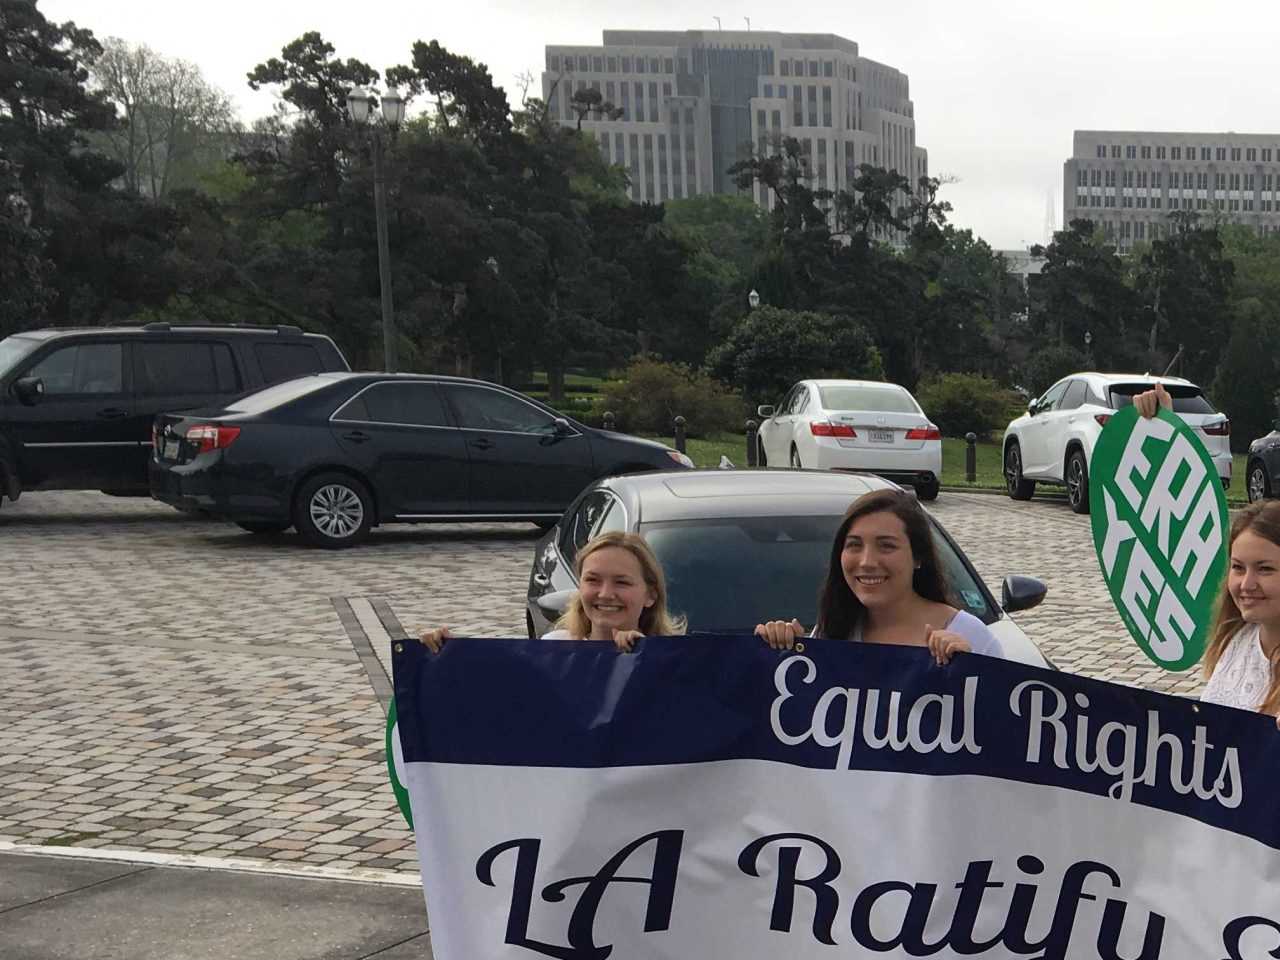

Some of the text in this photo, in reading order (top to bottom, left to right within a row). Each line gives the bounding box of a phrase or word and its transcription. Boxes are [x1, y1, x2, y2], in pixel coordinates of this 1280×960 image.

[1101, 484, 1196, 661] YES
[1114, 416, 1222, 600] ERA
[769, 655, 1243, 809] Equal Rights
